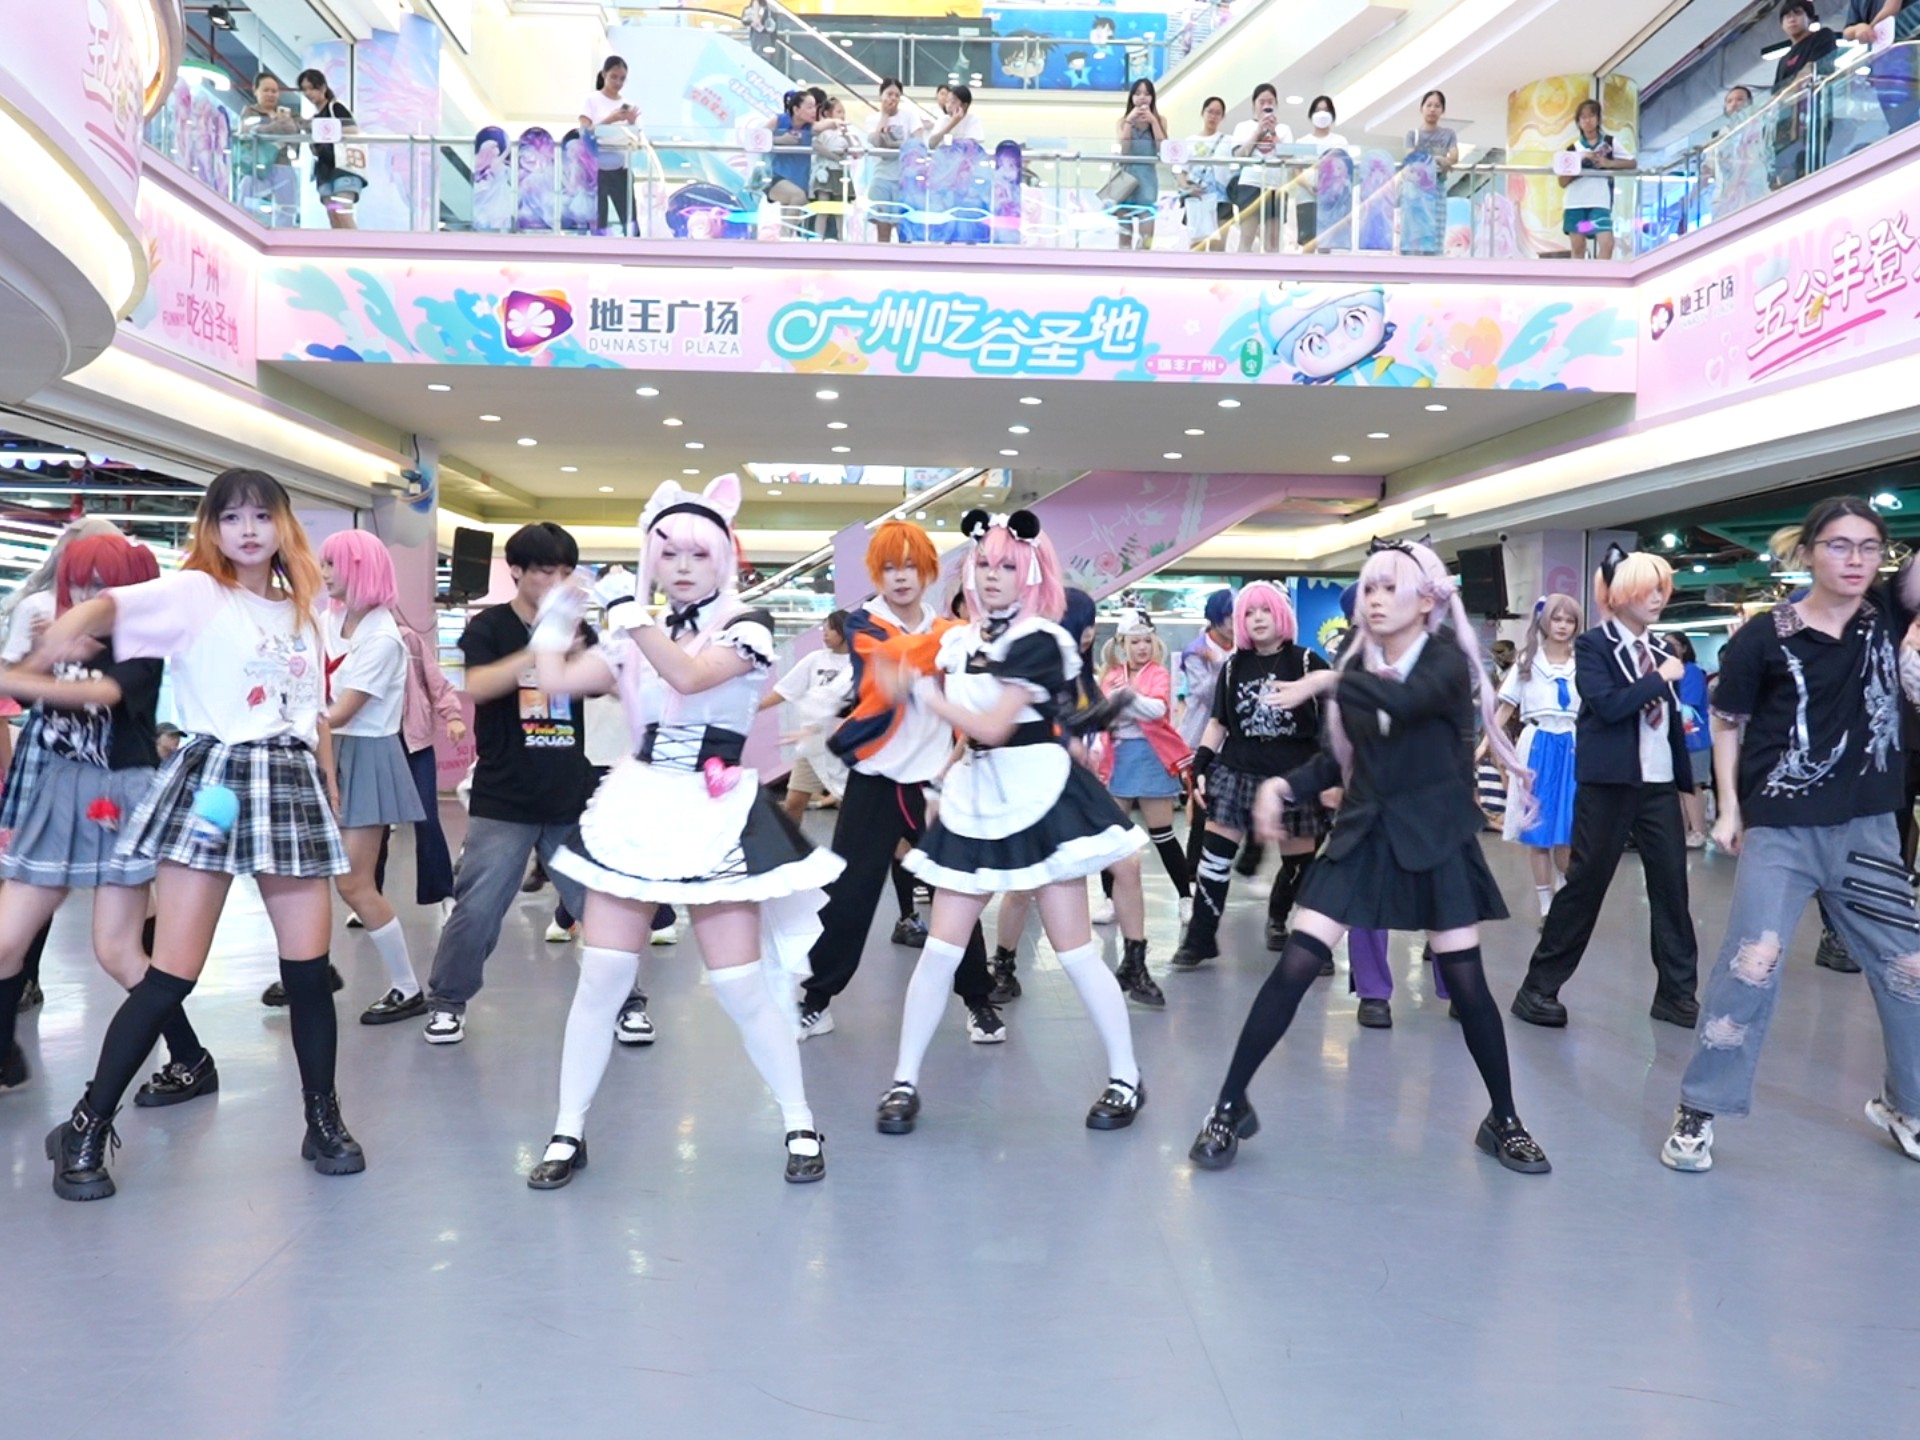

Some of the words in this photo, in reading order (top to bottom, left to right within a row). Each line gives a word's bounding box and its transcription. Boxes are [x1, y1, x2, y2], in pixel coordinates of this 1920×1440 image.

[191, 247, 219, 297] 广州
[1747, 210, 1920, 360] 五谷丰登
[589, 298, 740, 335] 地王广场
[1679, 275, 1734, 317] 地王广场
[187, 294, 238, 354] 吃谷圣地
[589, 337, 669, 352] DYNASTY
[685, 340, 740, 355] PLAZA
[774, 296, 1143, 369] 广州吃谷圣地
[525, 735, 575, 746] SQUAD
